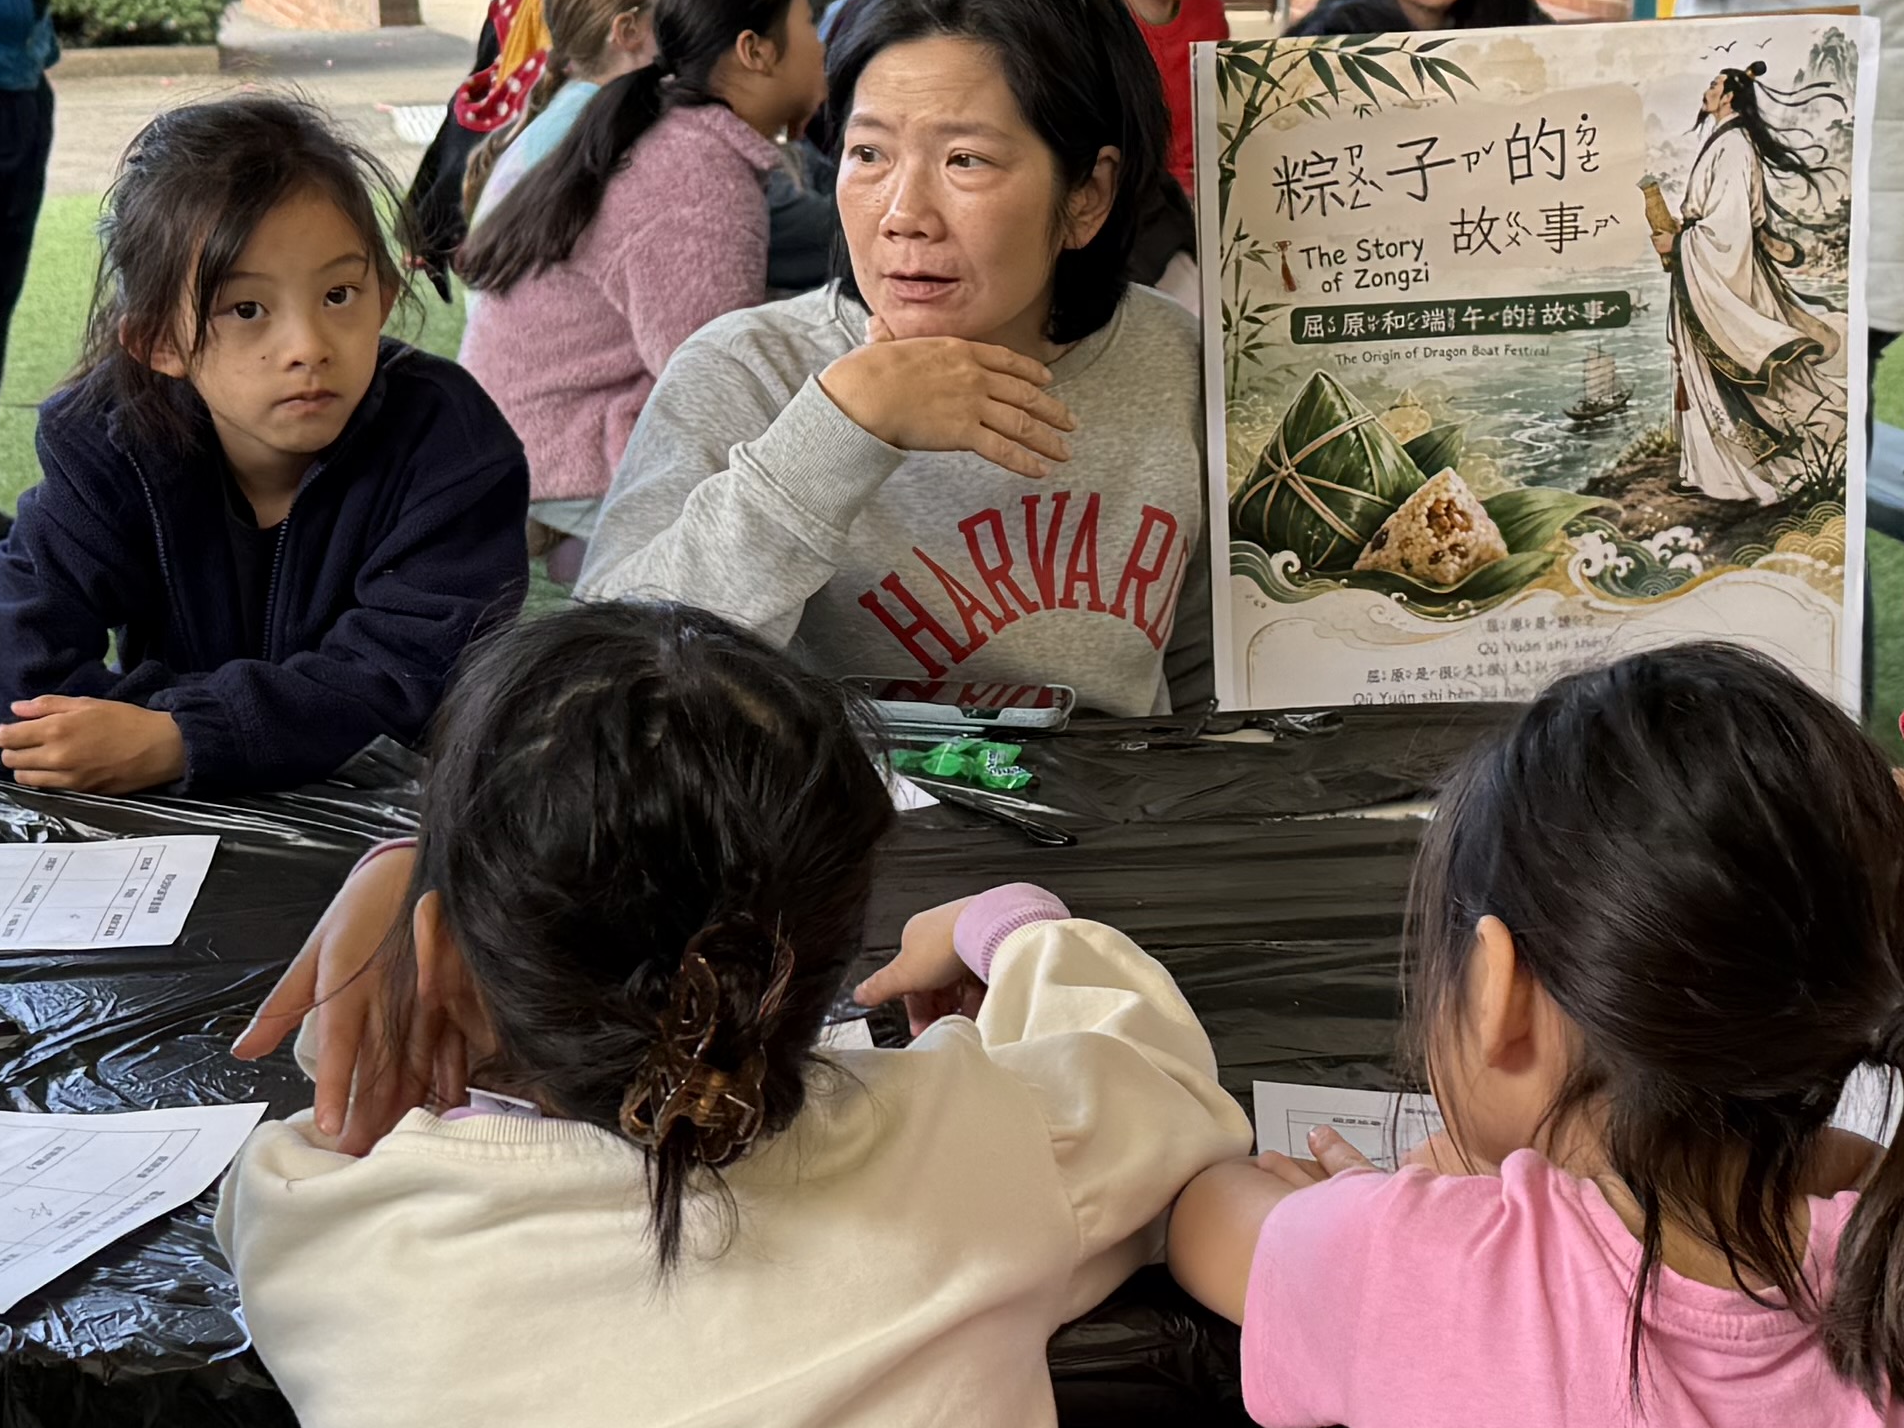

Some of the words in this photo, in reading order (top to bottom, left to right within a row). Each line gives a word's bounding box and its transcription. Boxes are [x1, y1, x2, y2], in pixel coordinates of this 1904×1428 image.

[1299, 244, 1348, 271] The
[1356, 237, 1425, 264] Story
[1321, 271, 1345, 294] of
[1354, 262, 1430, 292] Zongzi
[1335, 352, 1358, 366] The
[1362, 348, 1401, 365] Origin
[1405, 346, 1419, 360] of
[1423, 346, 1468, 362] Dragon
[1472, 344, 1500, 357] Boat
